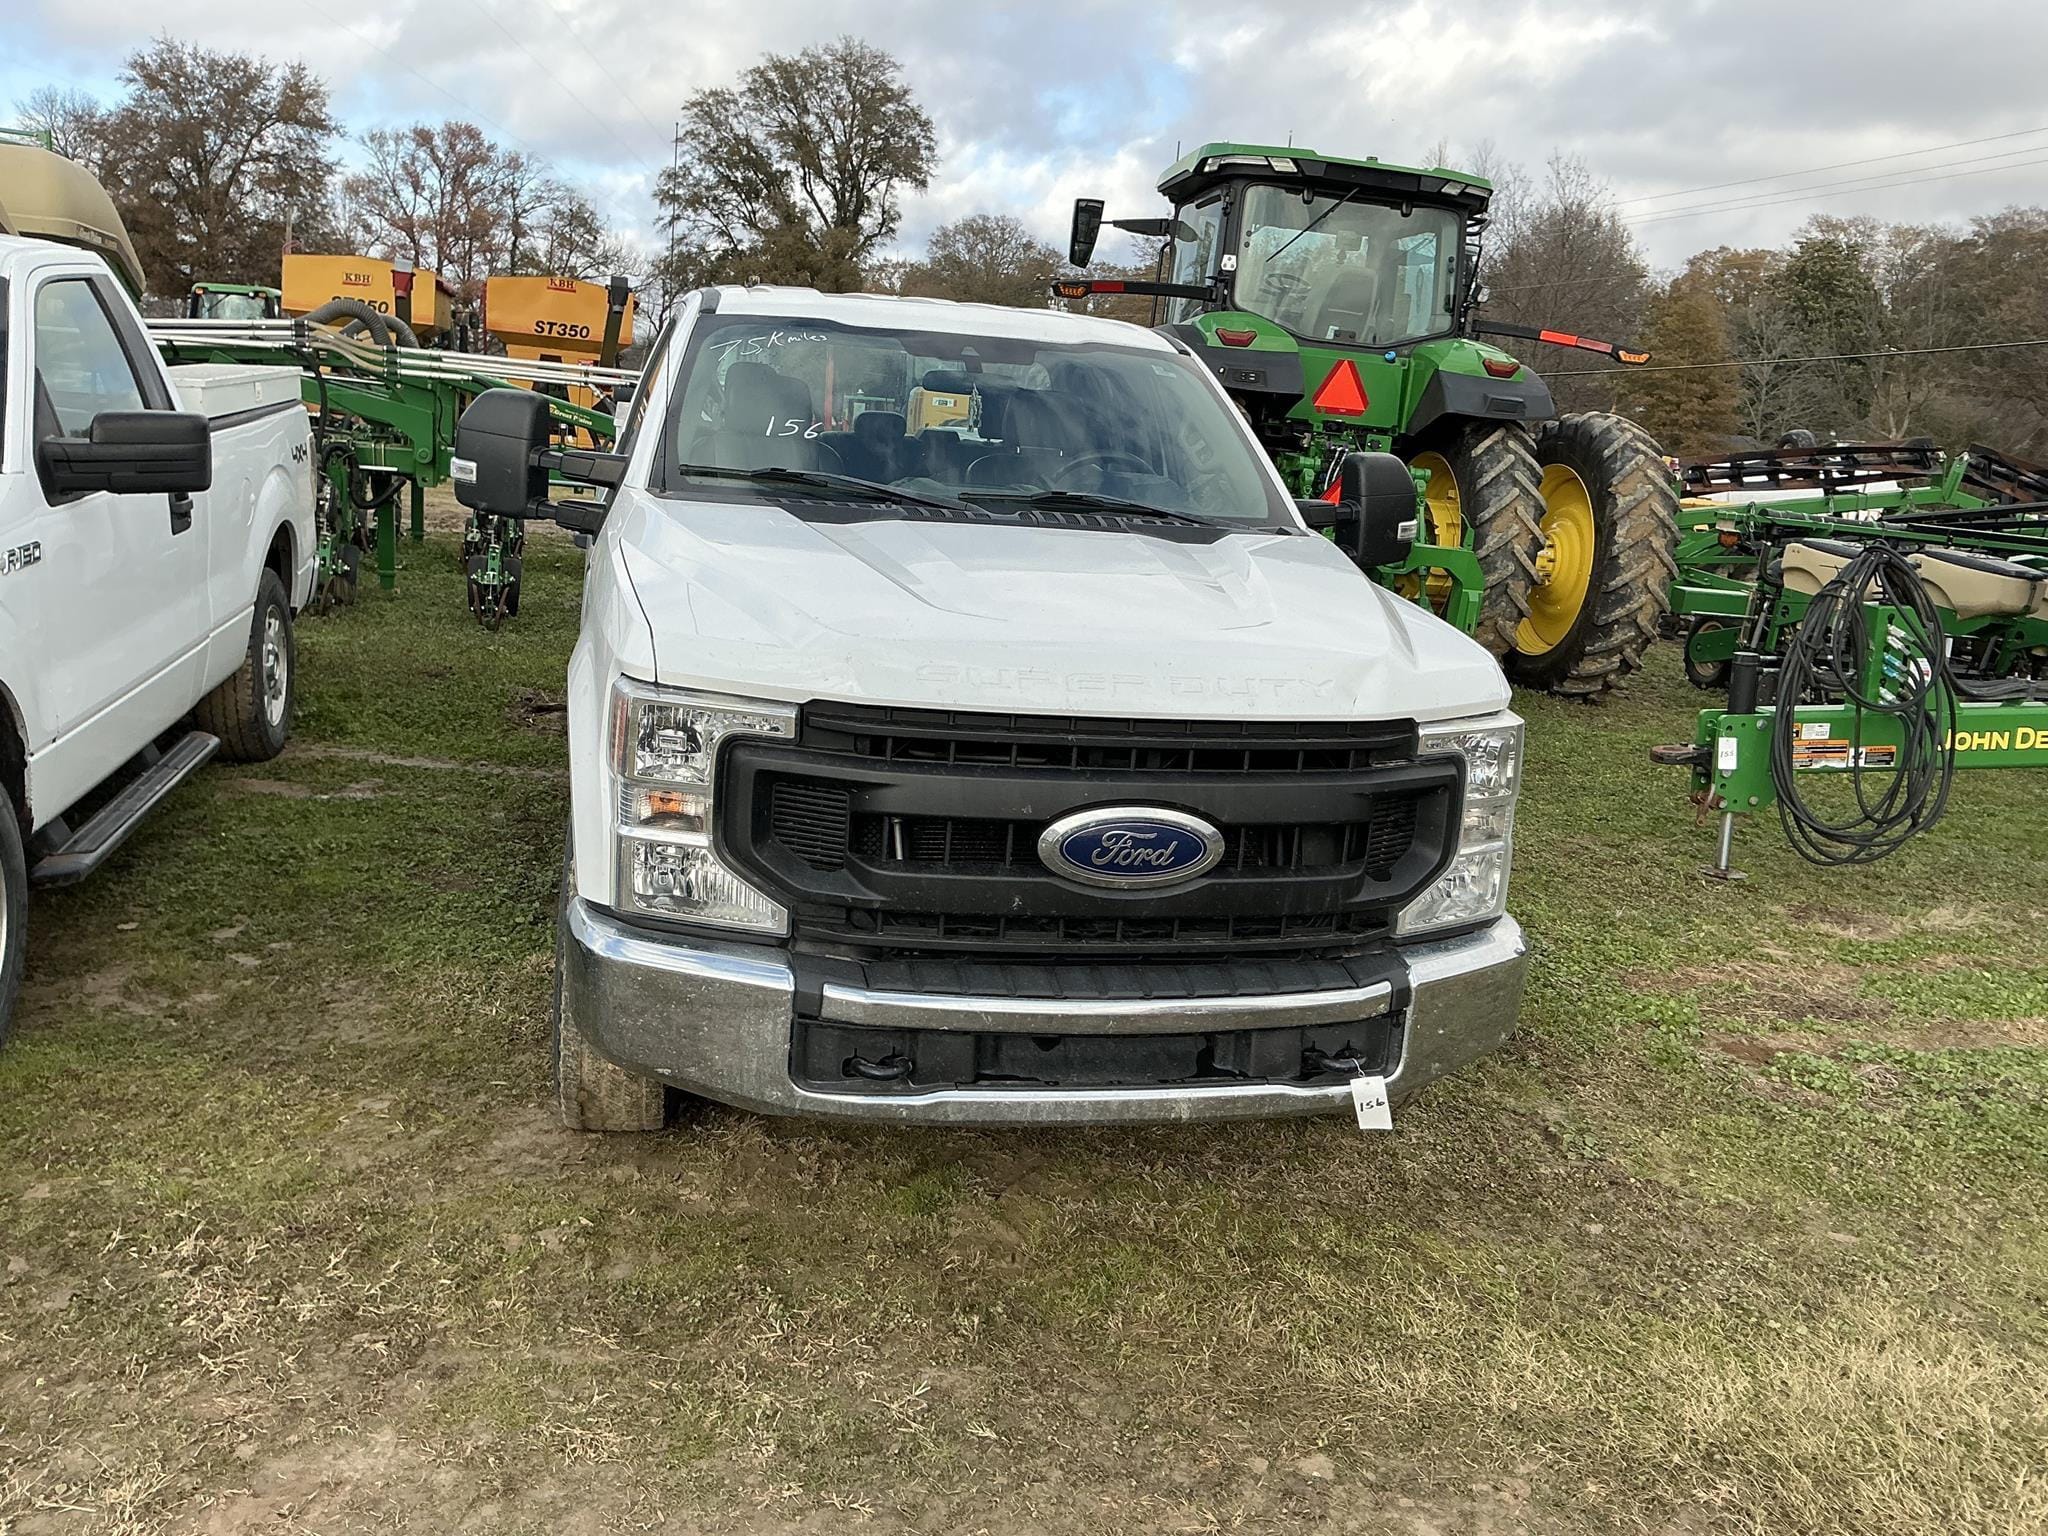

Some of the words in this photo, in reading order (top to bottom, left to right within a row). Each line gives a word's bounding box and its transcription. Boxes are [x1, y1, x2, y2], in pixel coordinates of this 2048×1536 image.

[345, 272, 370, 283] KBH
[549, 278, 574, 289] KBH
[534, 320, 590, 339] ST350
[765, 415, 823, 439] 156
[915, 664, 1151, 696] SUPER
[1168, 675, 1335, 697] DUTY
[1091, 830, 1178, 866] Ford
[1360, 1097, 1385, 1112] 156
